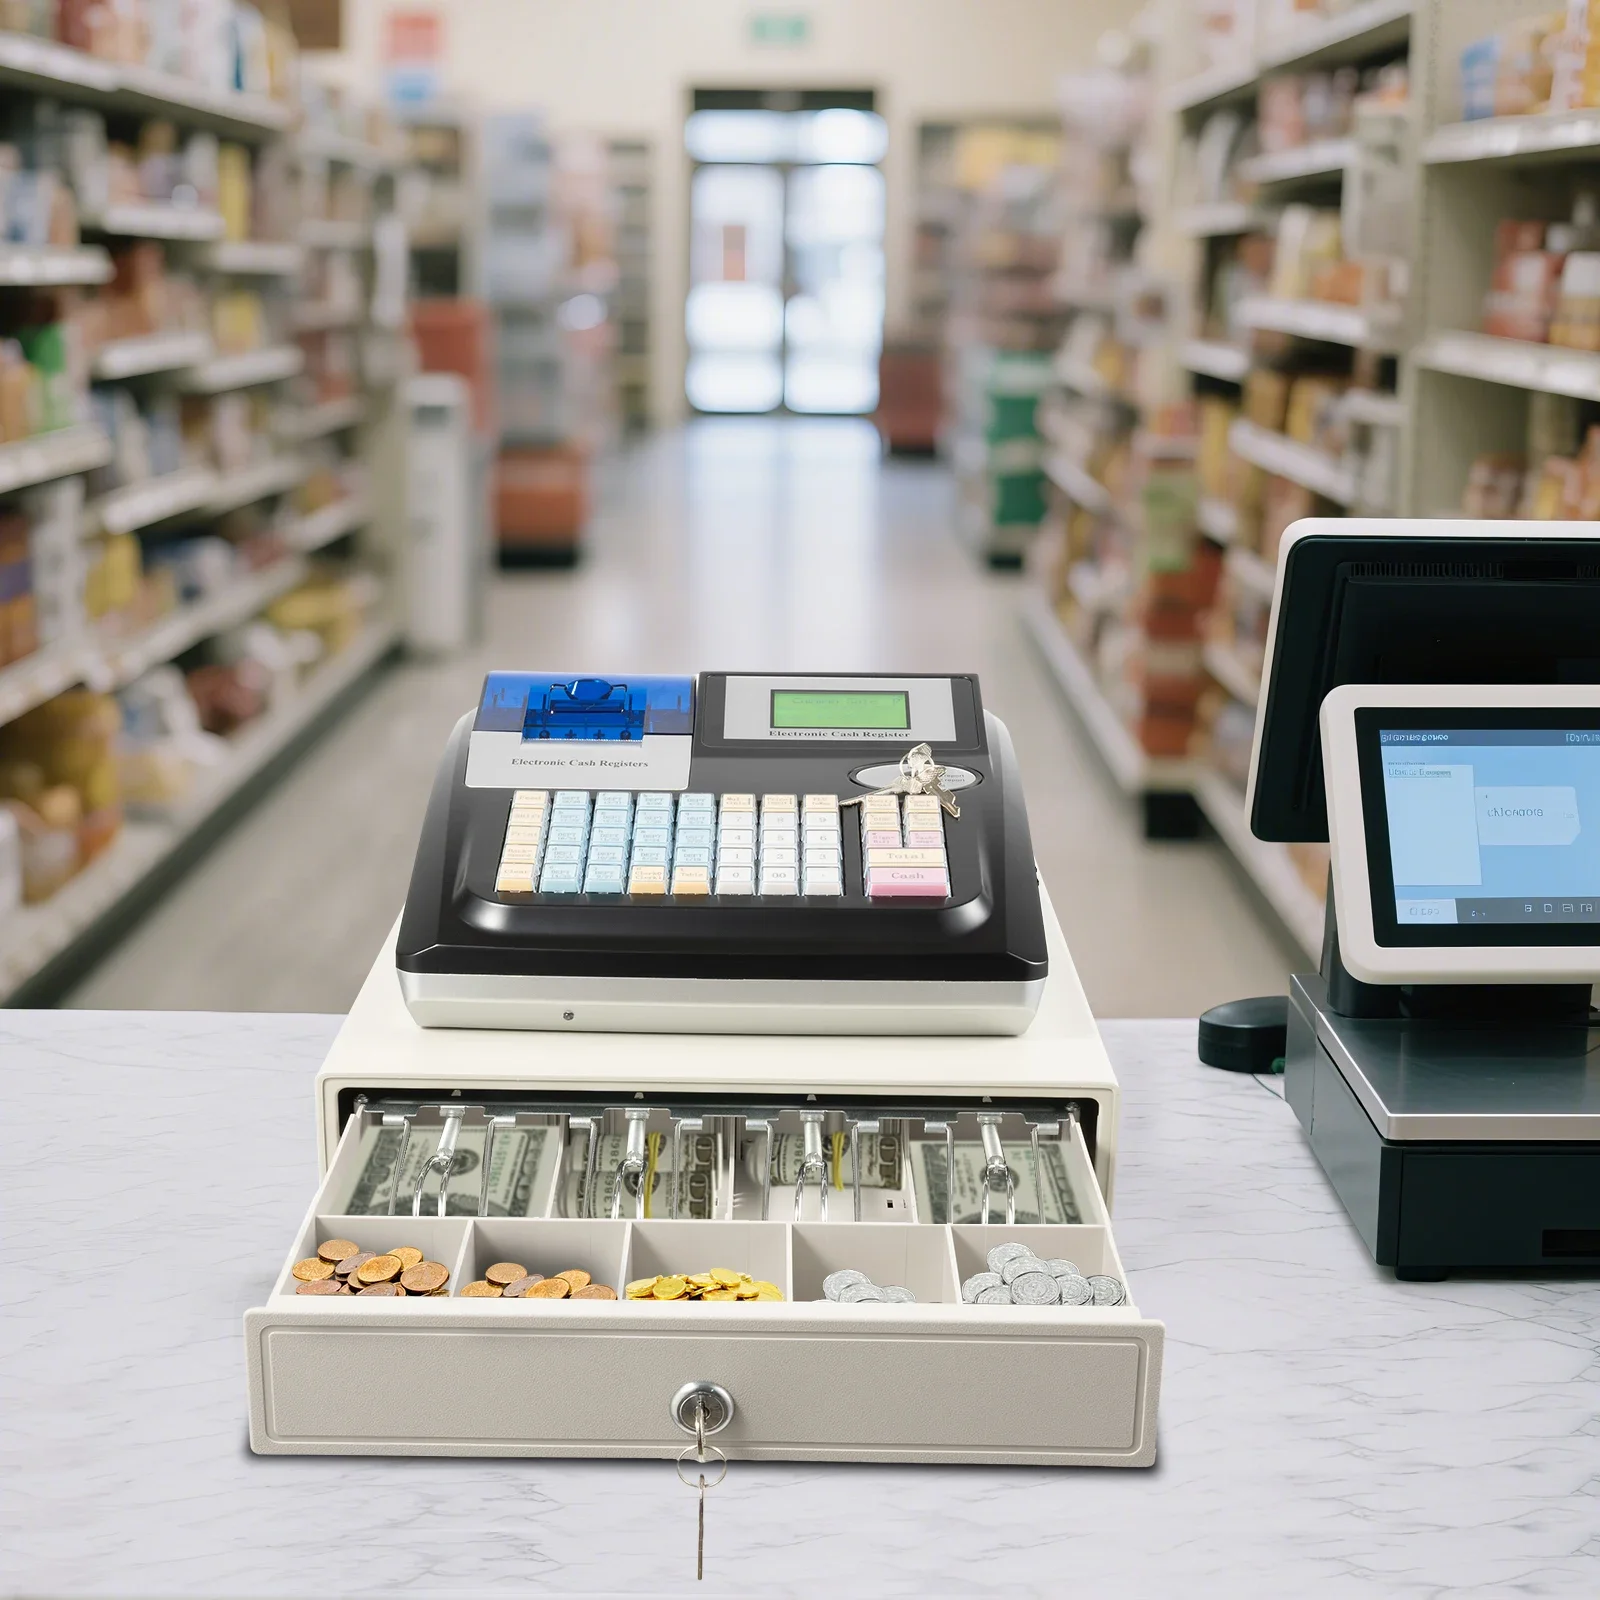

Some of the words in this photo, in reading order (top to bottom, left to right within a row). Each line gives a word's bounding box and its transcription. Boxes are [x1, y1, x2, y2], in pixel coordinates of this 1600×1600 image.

[769, 730, 828, 738] Electronic
[862, 731, 911, 739] Register
[511, 758, 566, 767] Electronic
[568, 758, 598, 768] Cash
[600, 758, 649, 770] Registers
[891, 872, 925, 880] Cash
